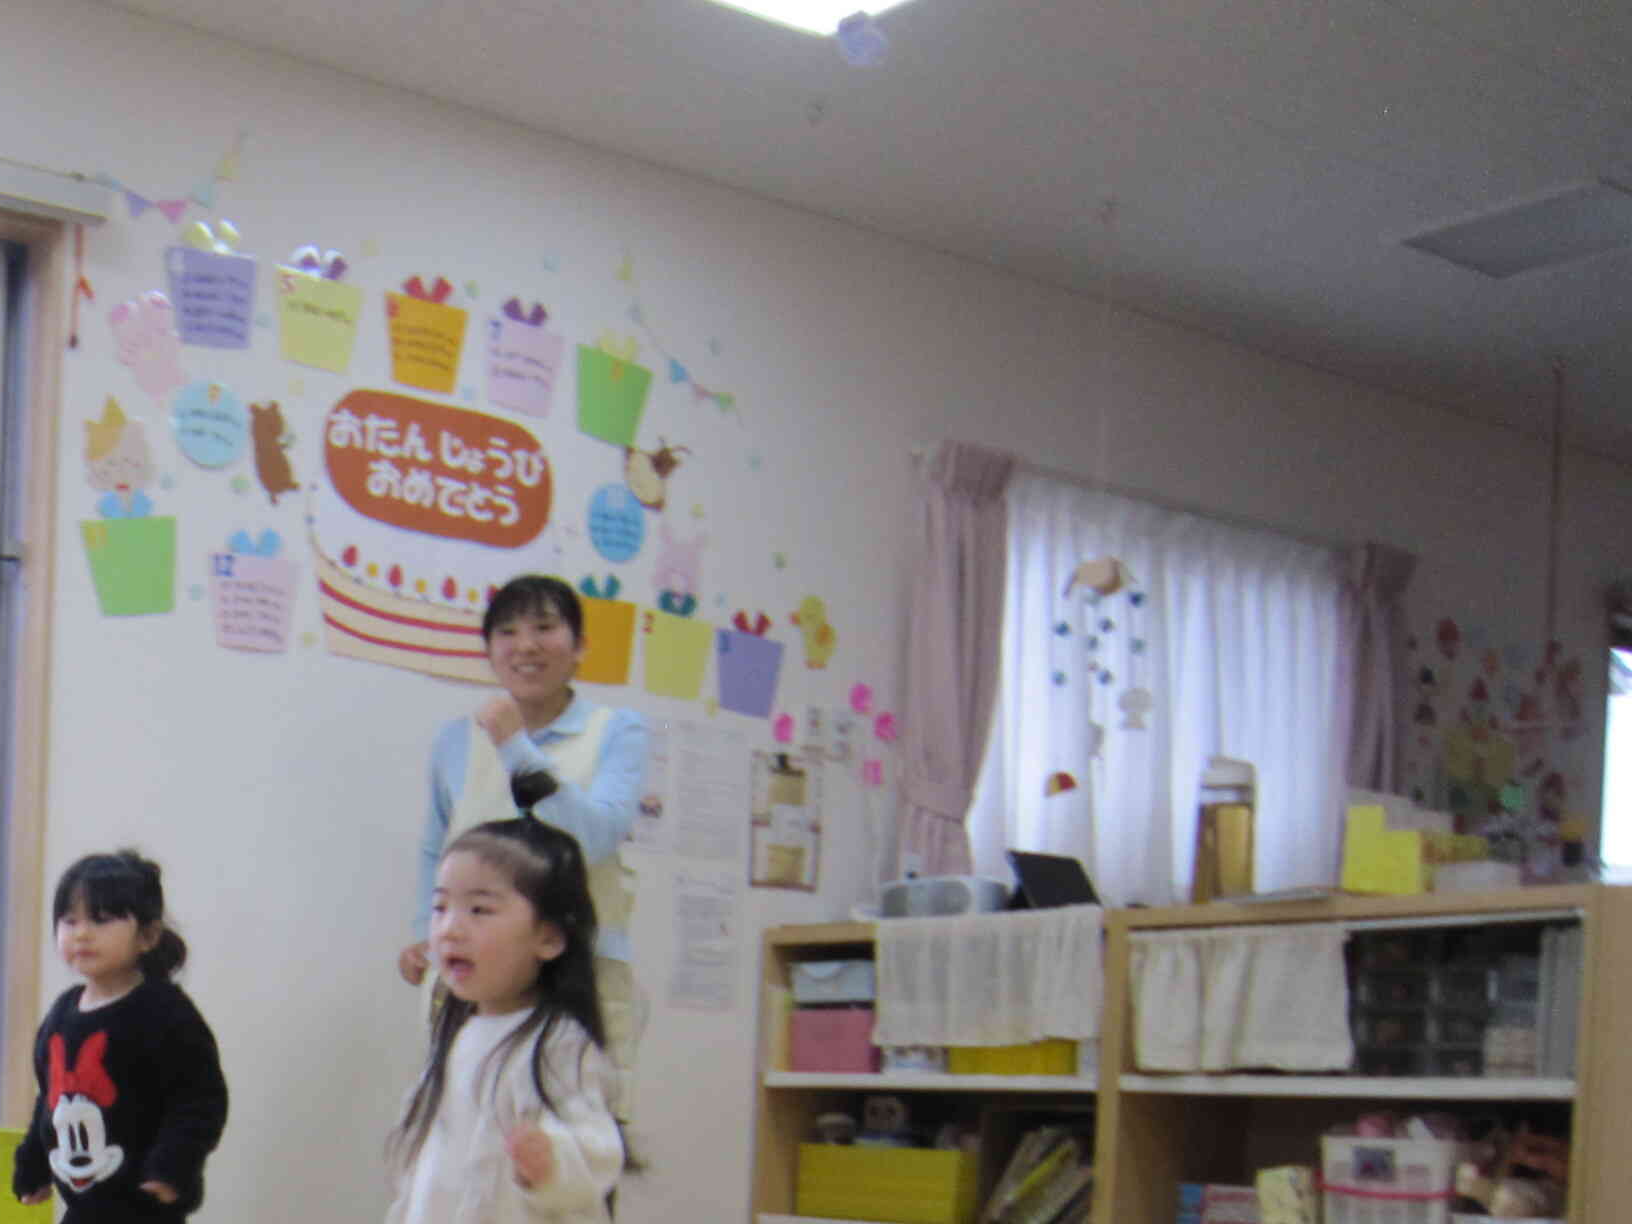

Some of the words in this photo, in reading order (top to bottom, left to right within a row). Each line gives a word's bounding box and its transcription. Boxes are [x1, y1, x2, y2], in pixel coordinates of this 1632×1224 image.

[366, 460, 521, 526] おめでとう
